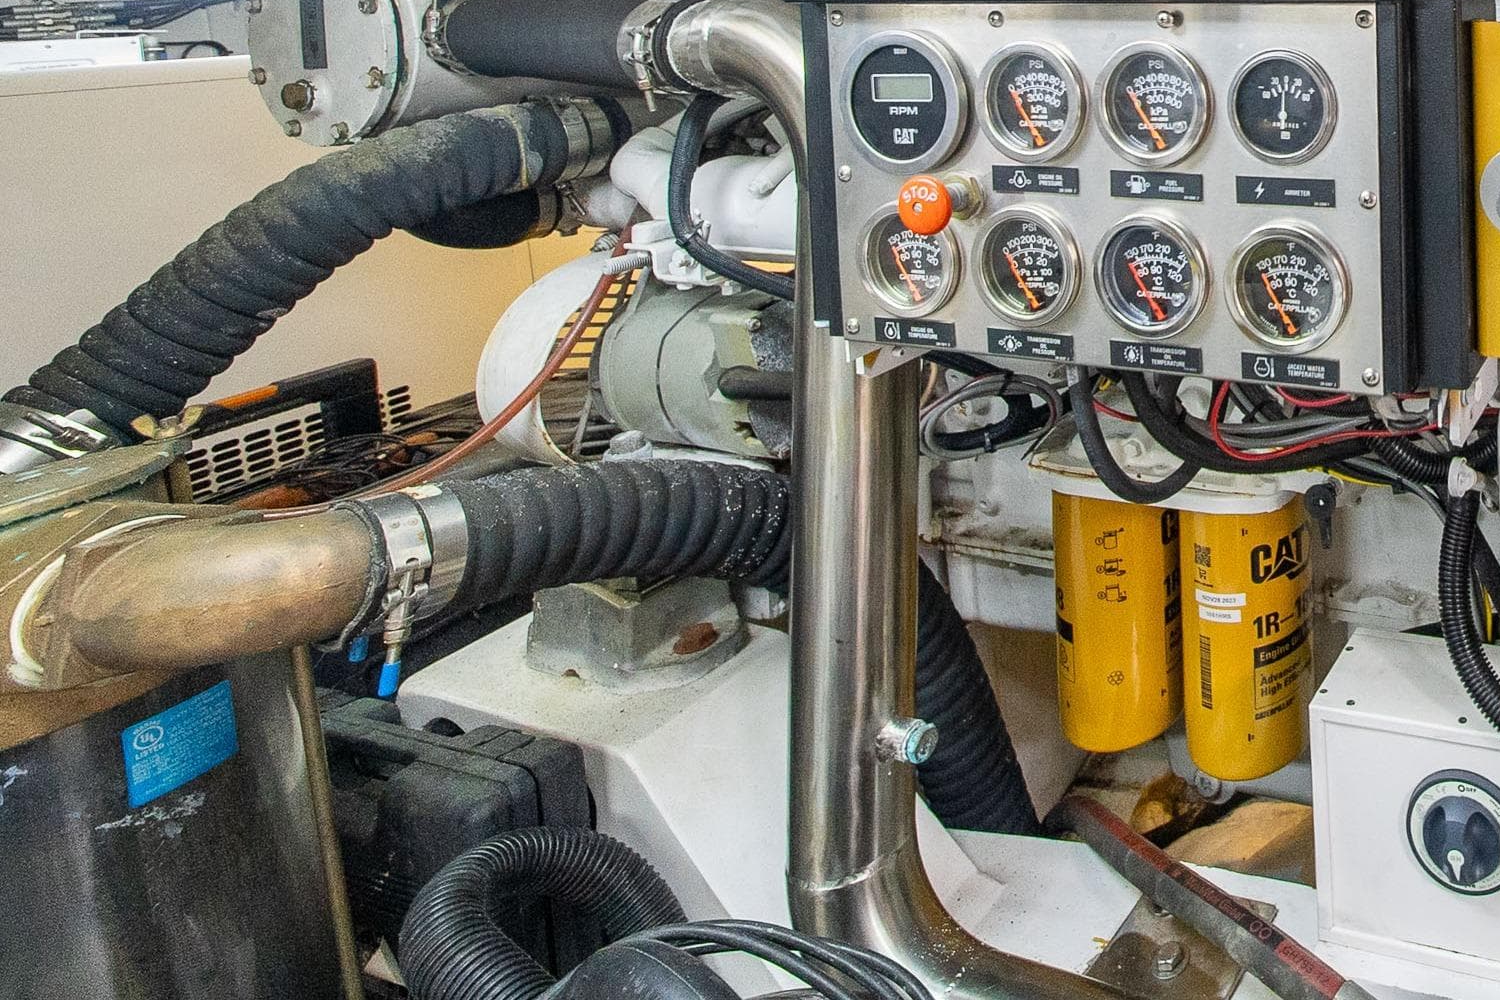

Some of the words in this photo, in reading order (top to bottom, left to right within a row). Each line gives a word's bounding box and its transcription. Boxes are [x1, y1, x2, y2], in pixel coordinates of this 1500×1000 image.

[1029, 60, 1044, 68] PSI
[1148, 60, 1164, 69] PSI
[1027, 73, 1037, 81] 40
[1145, 73, 1157, 82] 40
[1146, 95, 1164, 104] 300
[889, 106, 919, 115] RPM
[1030, 104, 1048, 114] kPa
[1150, 106, 1168, 116] kPa
[893, 128, 915, 144] CAT
[902, 185, 938, 203] STOP
[1022, 224, 1038, 232] PSI
[1007, 238, 1020, 248] 100
[1020, 235, 1036, 244] 200
[1036, 236, 1052, 247] 300
[1124, 246, 1139, 259] 130
[1139, 243, 1154, 253] 170
[1154, 244, 1171, 254] 210
[1022, 256, 1034, 266] 10
[1036, 257, 1048, 266] 20
[1256, 258, 1272, 270] 130
[1272, 254, 1288, 264] 170
[1290, 255, 1306, 266] 210
[1040, 268, 1052, 276] 100
[1150, 266, 1162, 274] 90
[1168, 269, 1183, 283] 120
[1284, 277, 1298, 287] 90
[1303, 282, 1318, 297] 120
[1288, 363, 1305, 371] JACKET
[1306, 364, 1326, 372] WATER
[1250, 523, 1304, 584] CAT
[1260, 642, 1290, 662] Engine
[135, 743, 165, 760] LISTED
